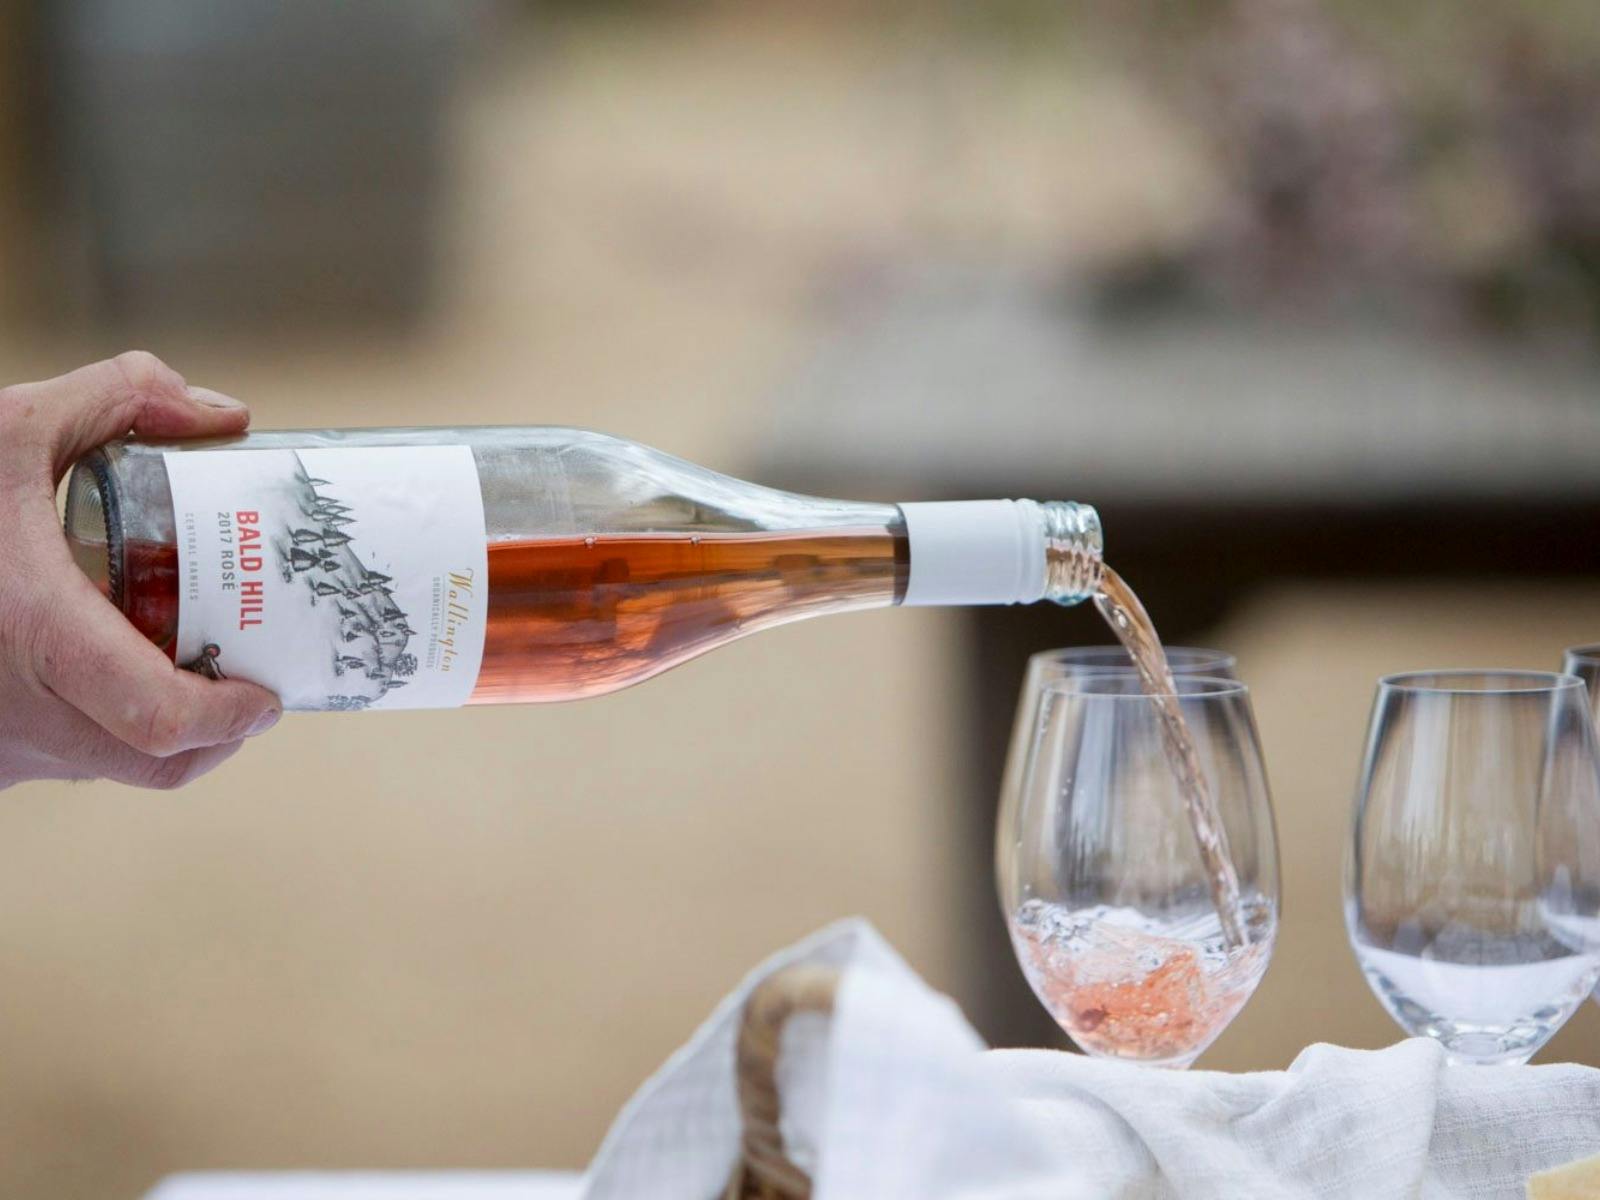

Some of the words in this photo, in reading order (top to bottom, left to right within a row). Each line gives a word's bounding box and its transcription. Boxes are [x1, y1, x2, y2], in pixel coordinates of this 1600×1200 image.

[184, 512, 197, 555] CENTRAL
[217, 511, 232, 543] 2017
[236, 511, 263, 572] BALD
[189, 560, 199, 600] RANGES
[221, 549, 239, 591] ROSÉ
[240, 581, 263, 631] HILL
[441, 567, 474, 672] Wallington
